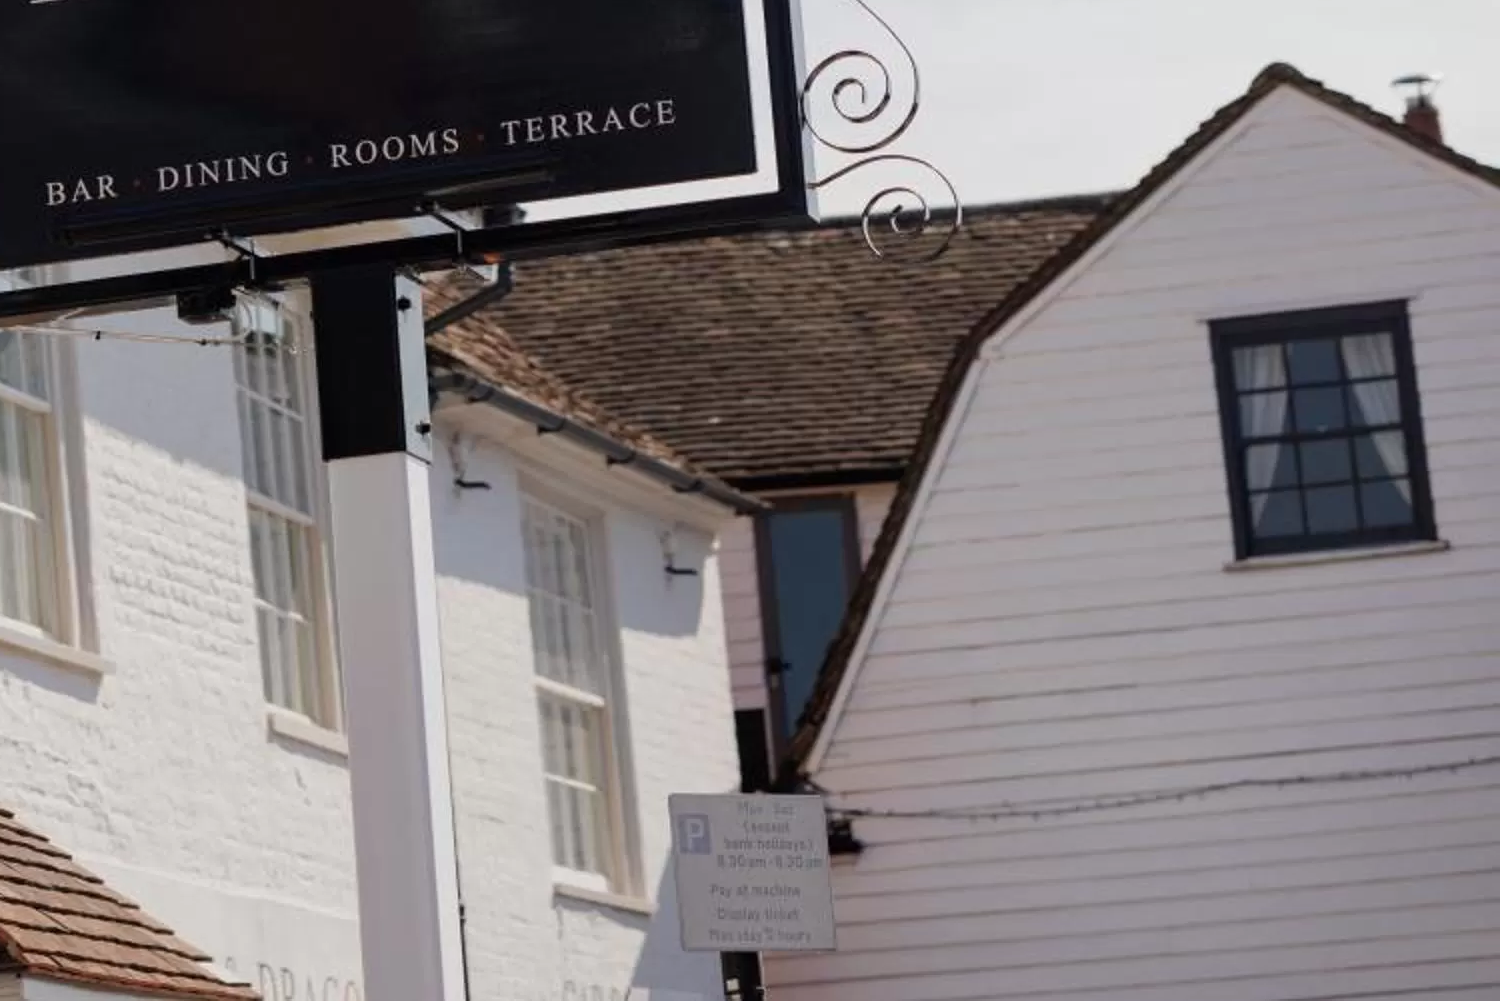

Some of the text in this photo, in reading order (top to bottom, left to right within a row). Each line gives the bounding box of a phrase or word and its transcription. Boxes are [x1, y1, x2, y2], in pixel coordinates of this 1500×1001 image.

[46, 99, 677, 206] BAR DINING ROOMS TERRACE
[709, 883, 801, 898] Pay at machine
